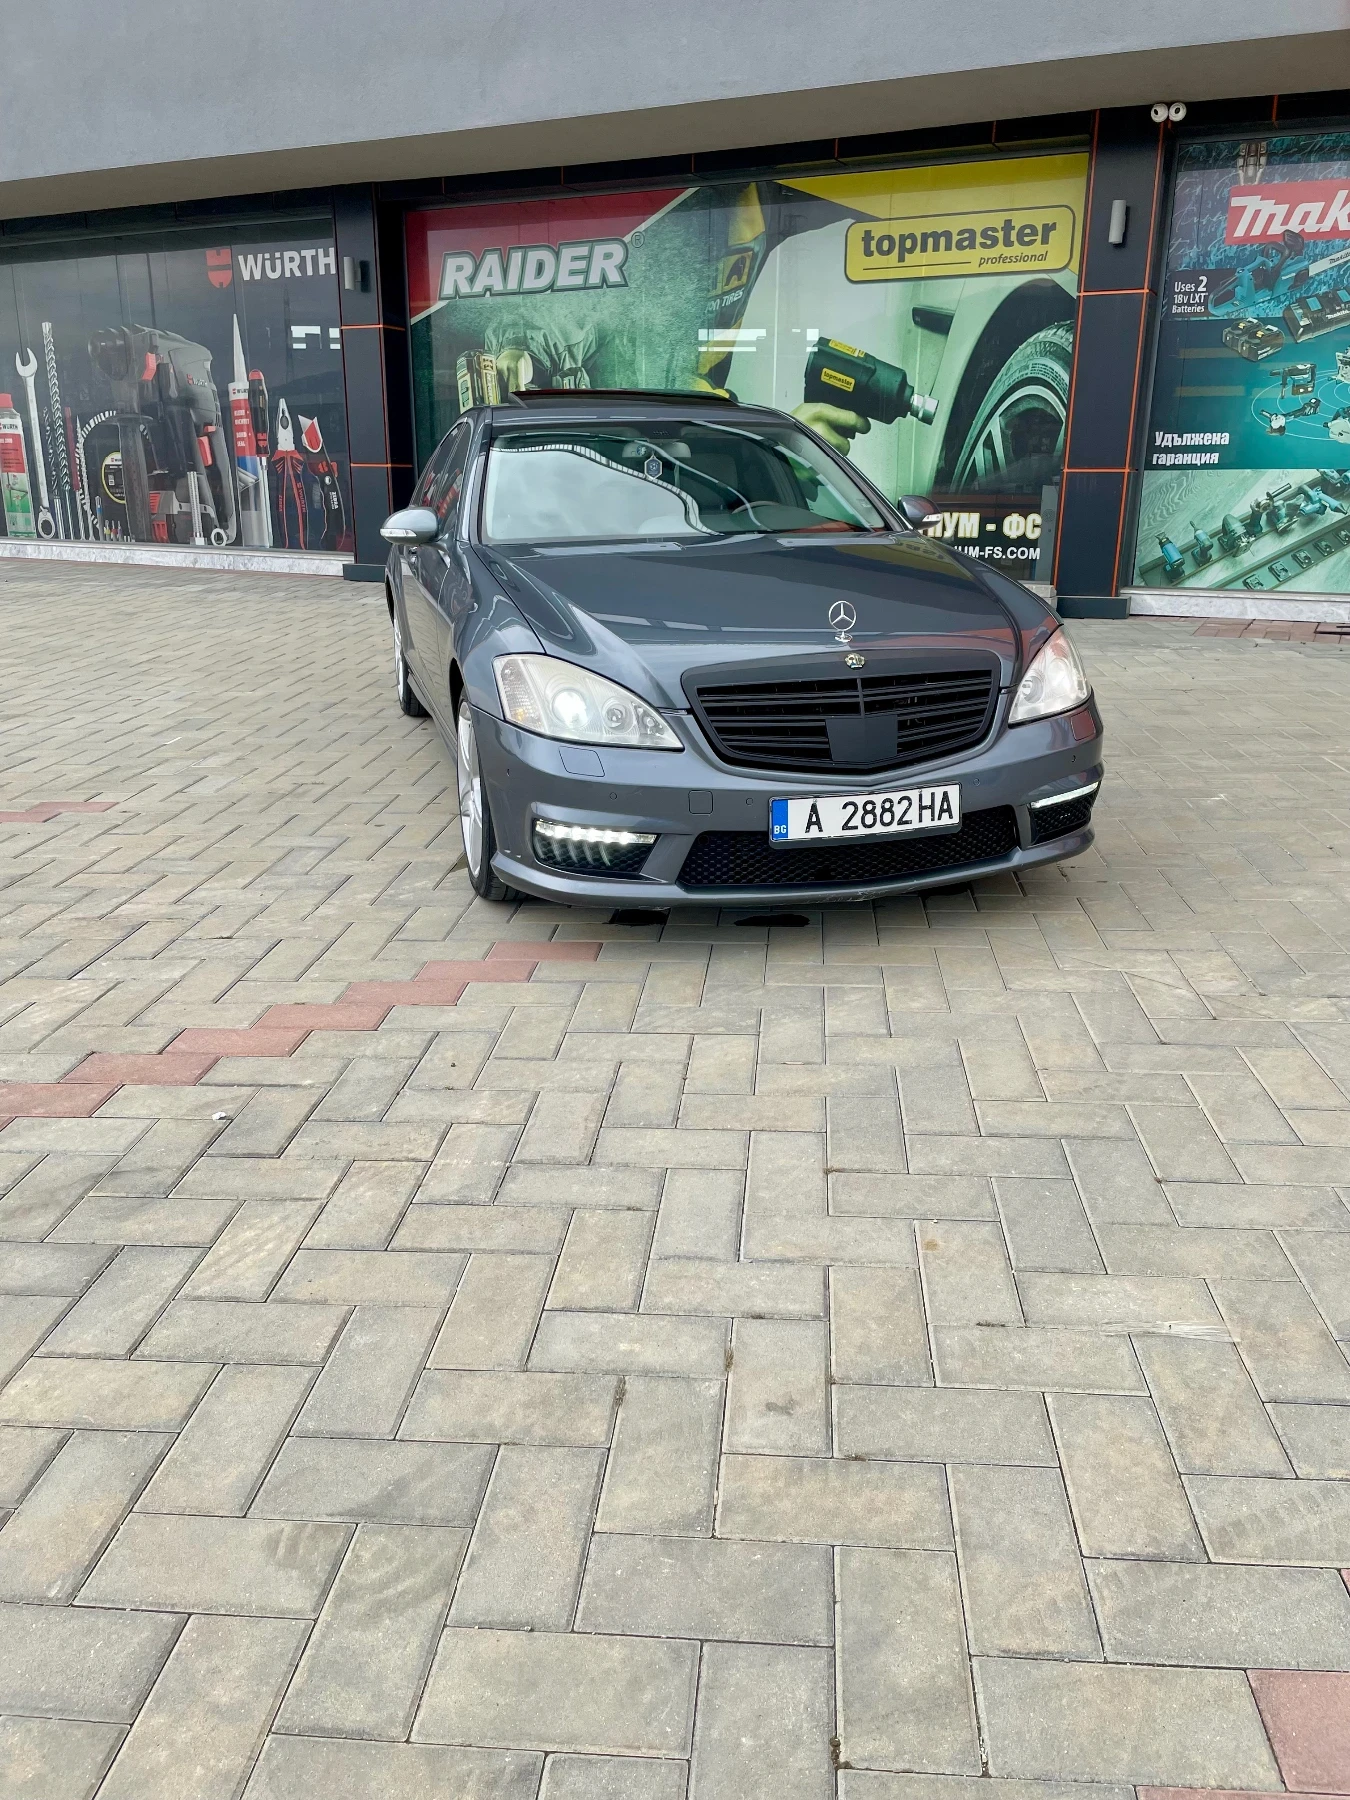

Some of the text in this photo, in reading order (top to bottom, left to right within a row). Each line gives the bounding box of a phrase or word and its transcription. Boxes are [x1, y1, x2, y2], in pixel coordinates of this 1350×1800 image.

[861, 219, 1057, 263] topmaster
[238, 247, 336, 281] WÜRTH
[978, 251, 1049, 267] professional
[440, 239, 626, 299] RAIDER
[1174, 275, 1208, 292] Uses 2
[1172, 304, 1205, 314] Batteries
[1155, 431, 1230, 448] Удължена
[1152, 452, 1220, 467] гаранция
[1002, 512, 1042, 540] ФС
[805, 802, 824, 834] A
[773, 825, 787, 834] BG
